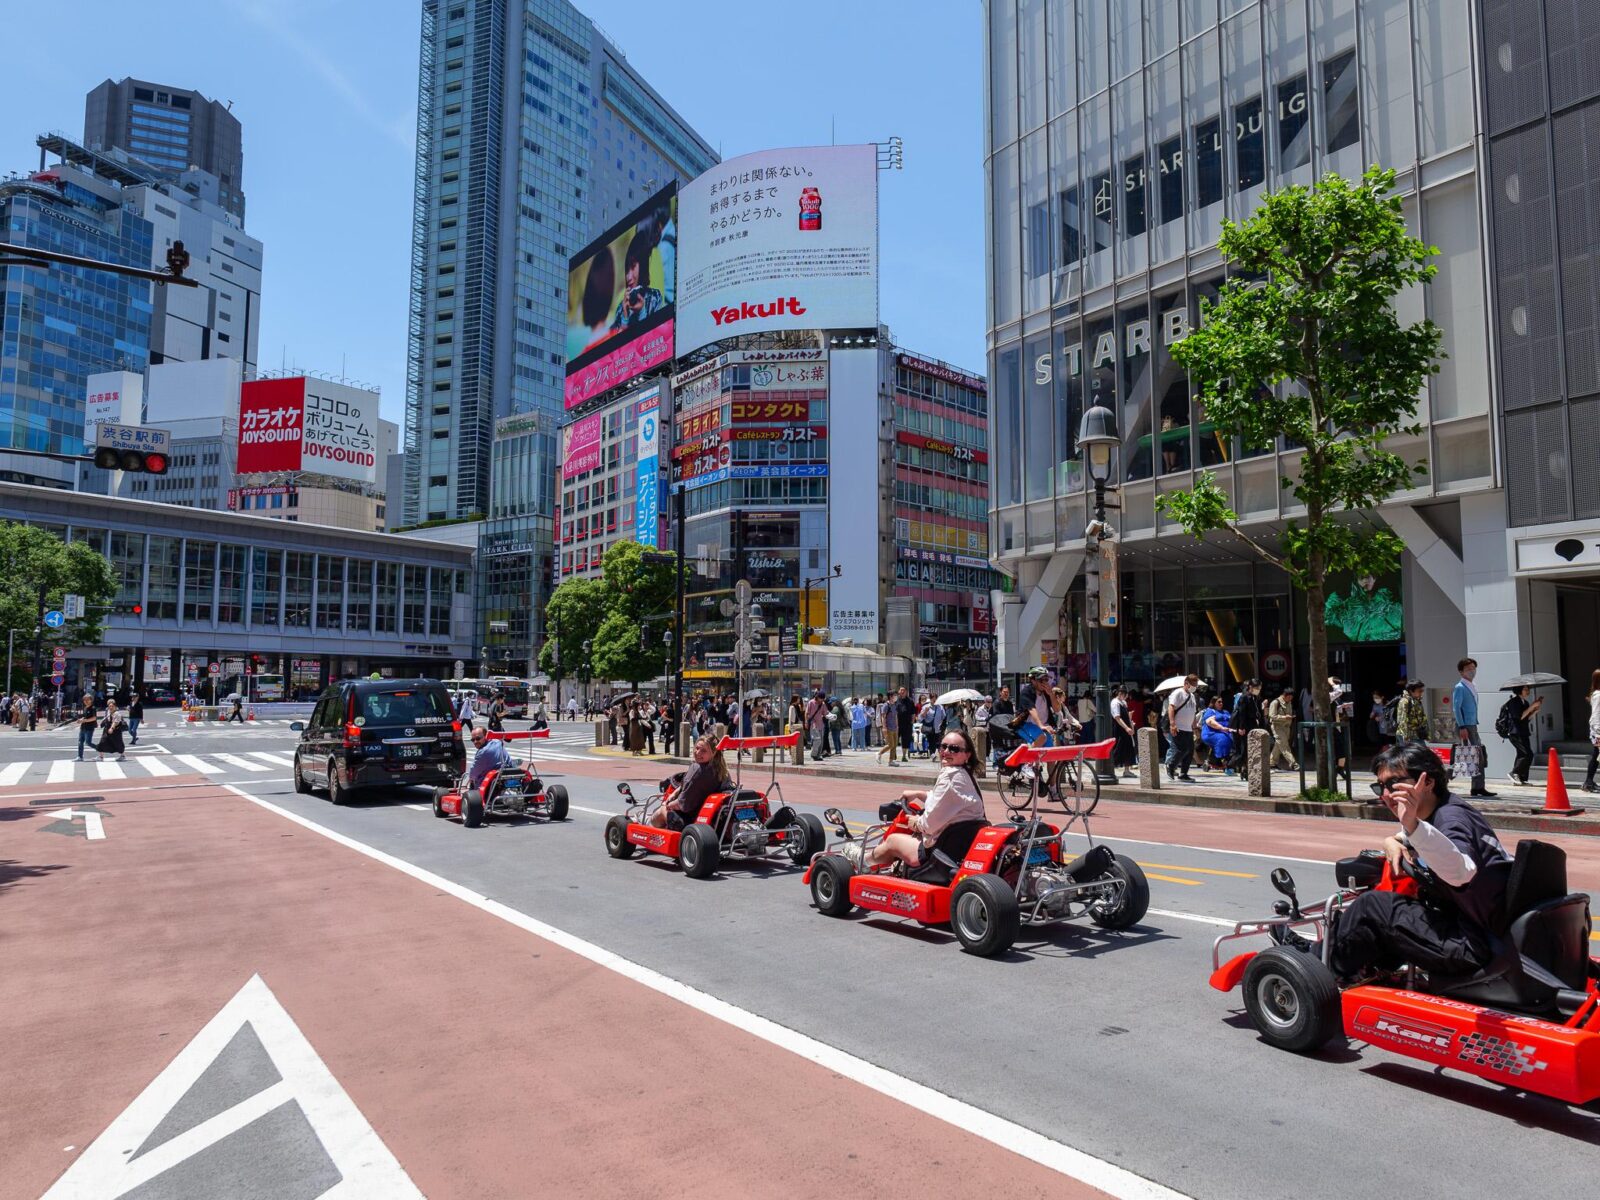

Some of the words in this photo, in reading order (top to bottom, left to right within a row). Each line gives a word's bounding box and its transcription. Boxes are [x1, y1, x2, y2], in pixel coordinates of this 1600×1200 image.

[1125, 150, 1183, 192] SHAR
[1213, 92, 1306, 152] LOUG
[710, 166, 813, 196] まわりは関係ない。
[710, 186, 778, 215] 納得するまで
[40, 206, 70, 223] TOKYU
[72, 219, 101, 236] PLAZA
[710, 206, 783, 232] やるかどうか。
[710, 296, 806, 326] Yakult
[742, 350, 822, 361] しゃぶしゃぶバイキング
[777, 366, 825, 382] しゃぶ葉
[89, 392, 119, 404] 広告募集
[307, 394, 361, 418] ココロの
[242, 407, 301, 430] カラオケ
[732, 403, 806, 418] コンタクト
[306, 412, 375, 438] ボリューム、
[103, 427, 164, 444] 渋谷駅前
[241, 428, 301, 444] JOYSOUND
[305, 428, 375, 451] あげていこう。
[702, 434, 720, 451] ガスト
[782, 427, 818, 442] ガスト
[112, 441, 140, 449] Shibuya
[953, 445, 975, 460] ガスト
[303, 442, 374, 467] JOYSOUND
[674, 466, 682, 477] 7F
[694, 454, 717, 474] ガスト
[761, 466, 826, 476] 英会話イーオン
[833, 610, 875, 618] 広告主募集中
[1266, 661, 1285, 670] LDH
[861, 891, 888, 902] Kart
[1376, 1020, 1450, 1048] Kart
